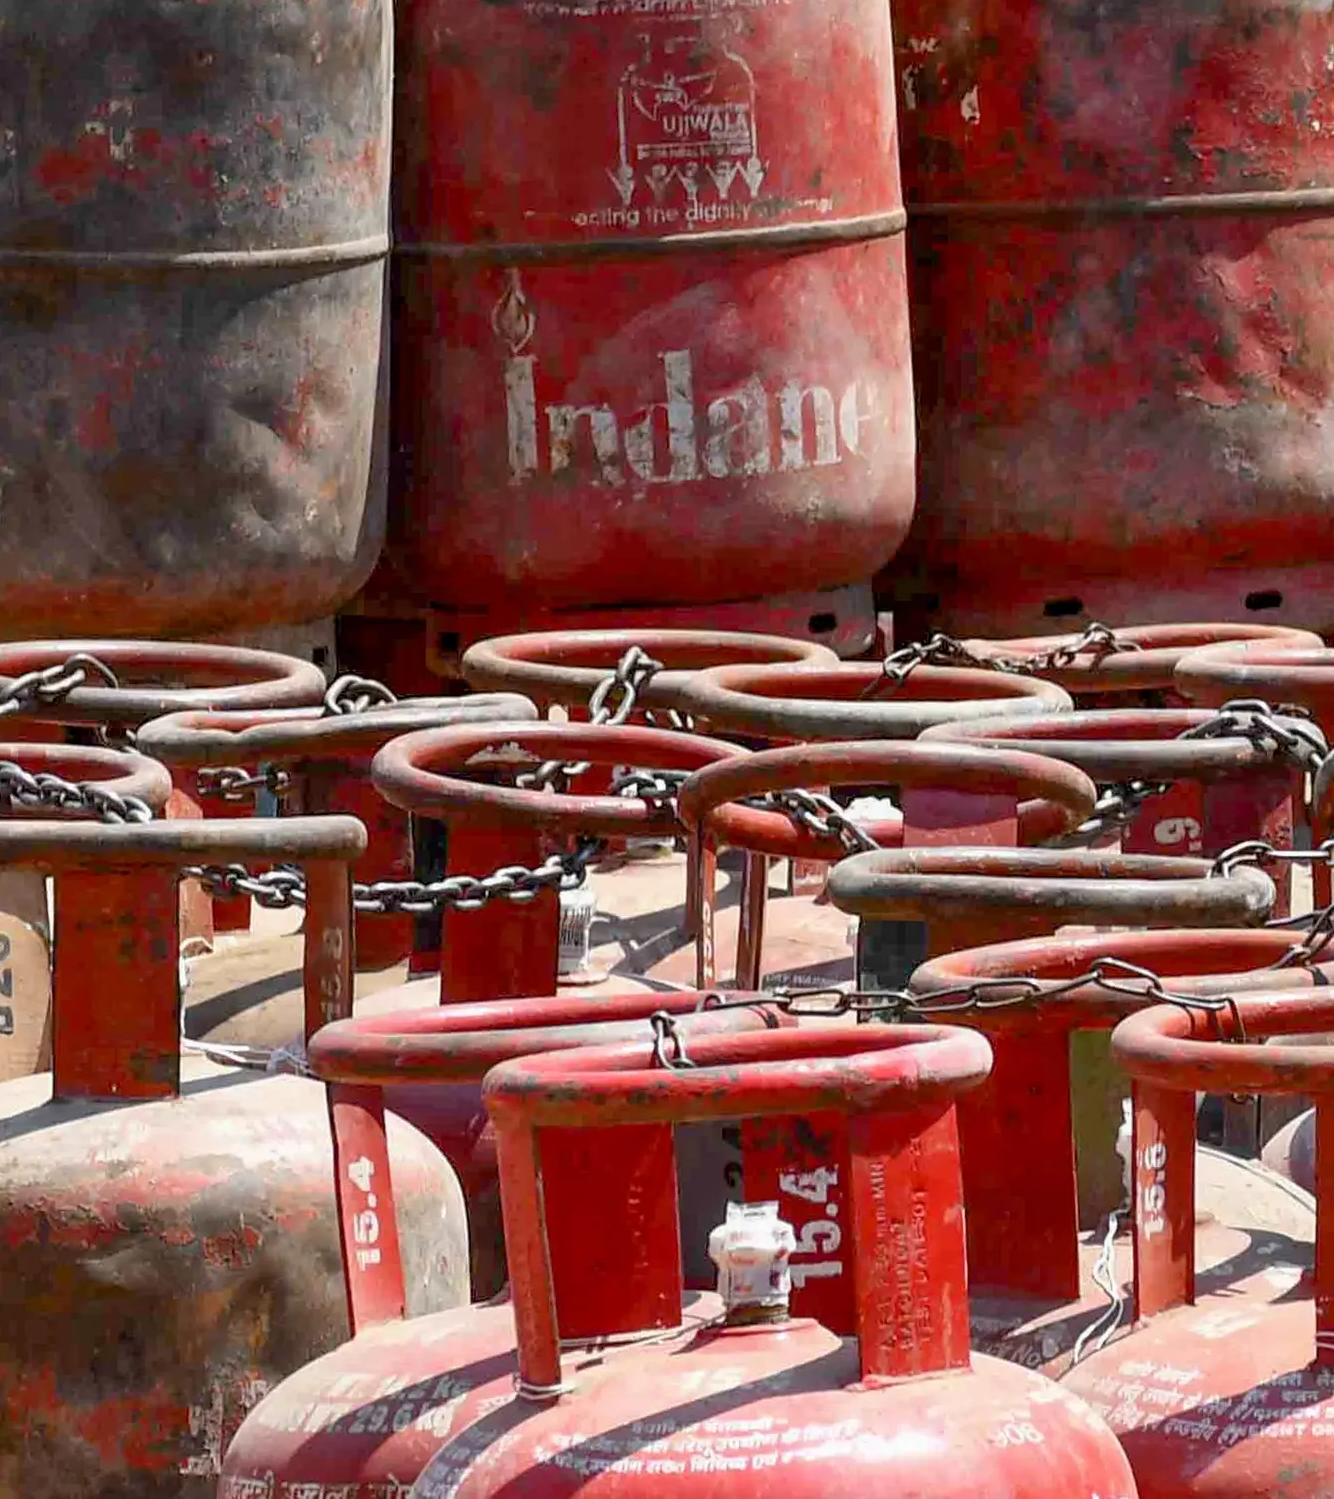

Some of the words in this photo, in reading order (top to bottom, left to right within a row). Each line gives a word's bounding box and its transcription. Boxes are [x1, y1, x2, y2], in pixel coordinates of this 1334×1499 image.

[504, 348, 884, 488] Indane
[348, 1155, 381, 1272] 15.4
[780, 1164, 842, 1289] 15.4
